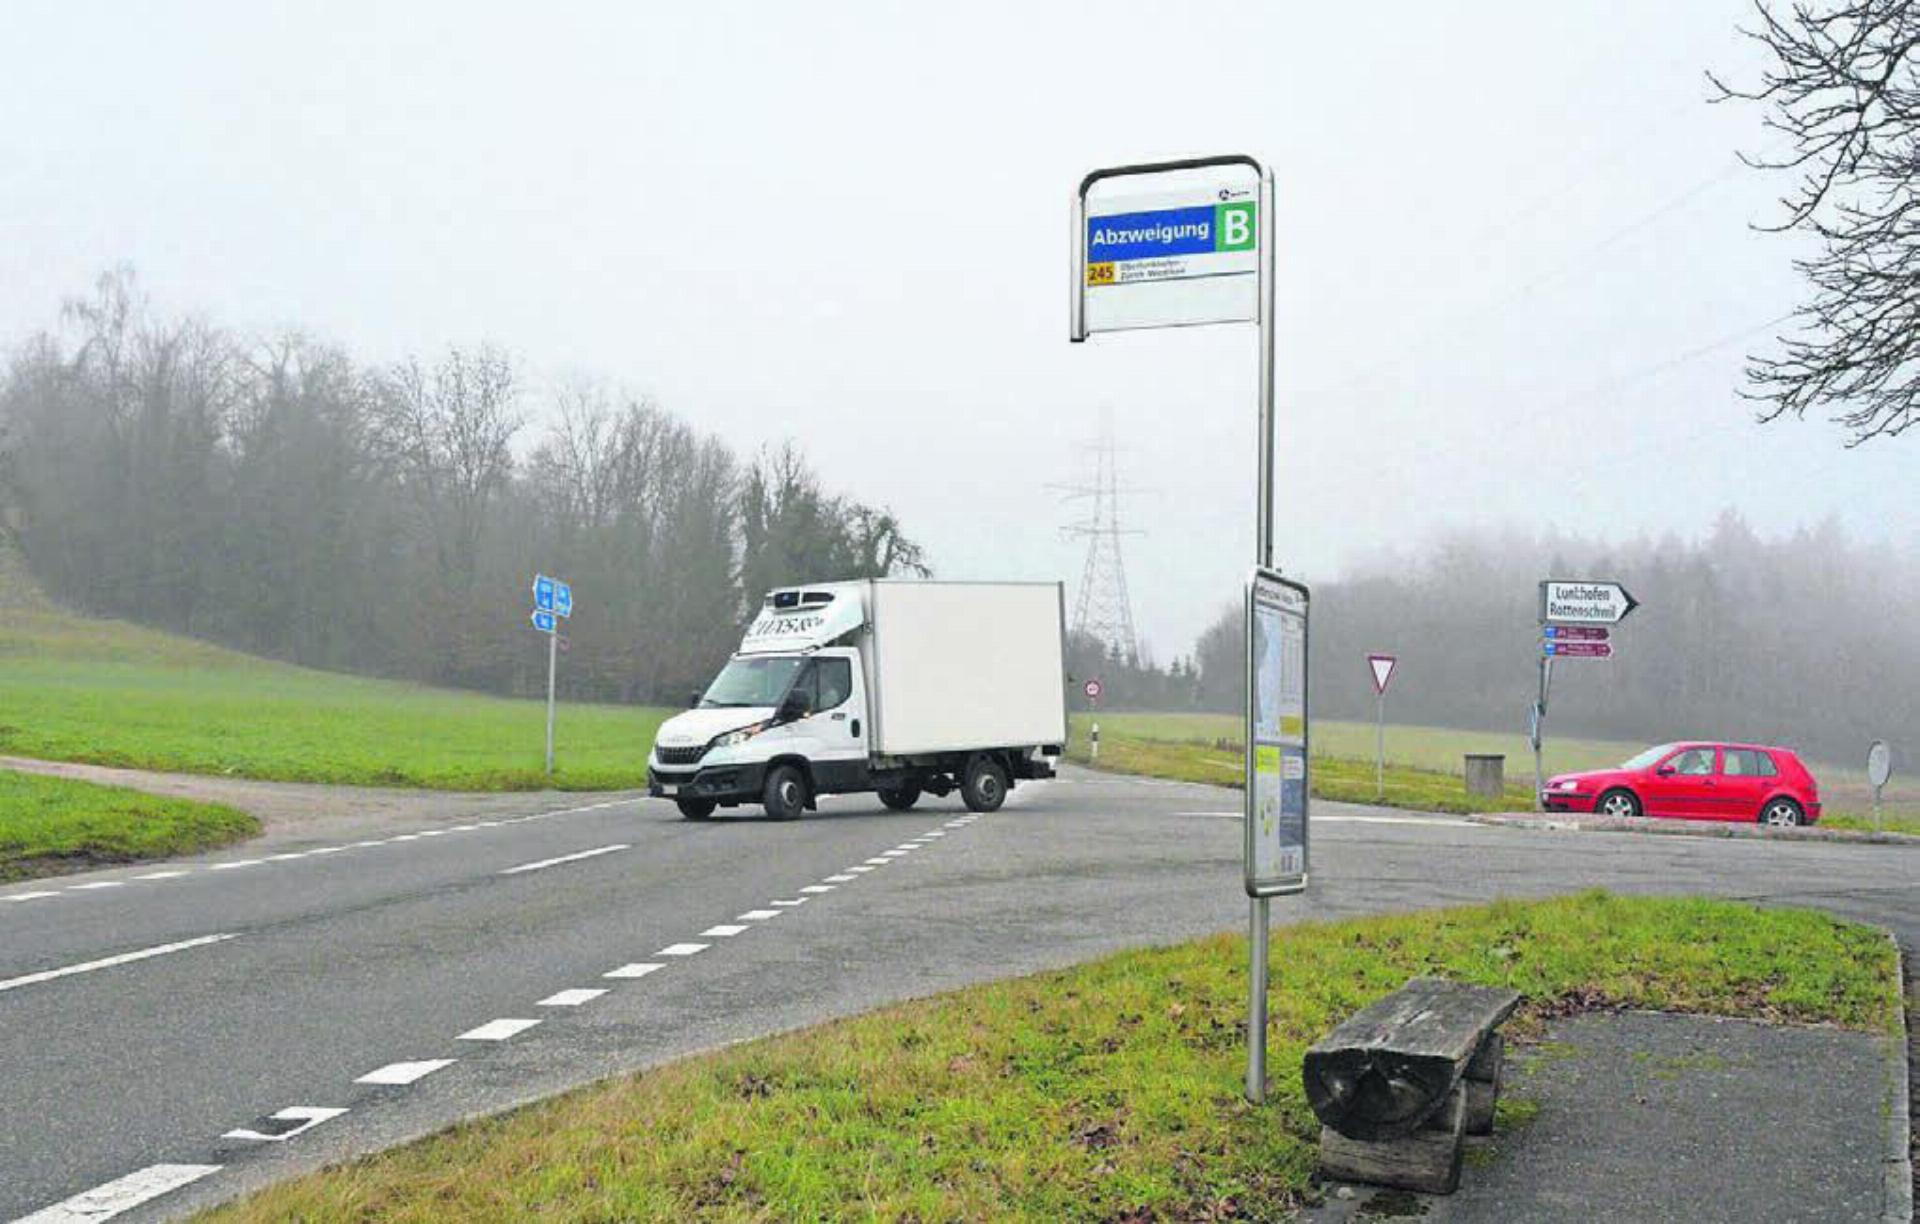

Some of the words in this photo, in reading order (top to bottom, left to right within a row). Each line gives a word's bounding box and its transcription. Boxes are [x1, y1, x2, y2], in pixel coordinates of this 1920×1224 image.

[1092, 221, 1209, 246] Abzweigung
[1224, 209, 1249, 245] B
[1089, 266, 1113, 281] 245
